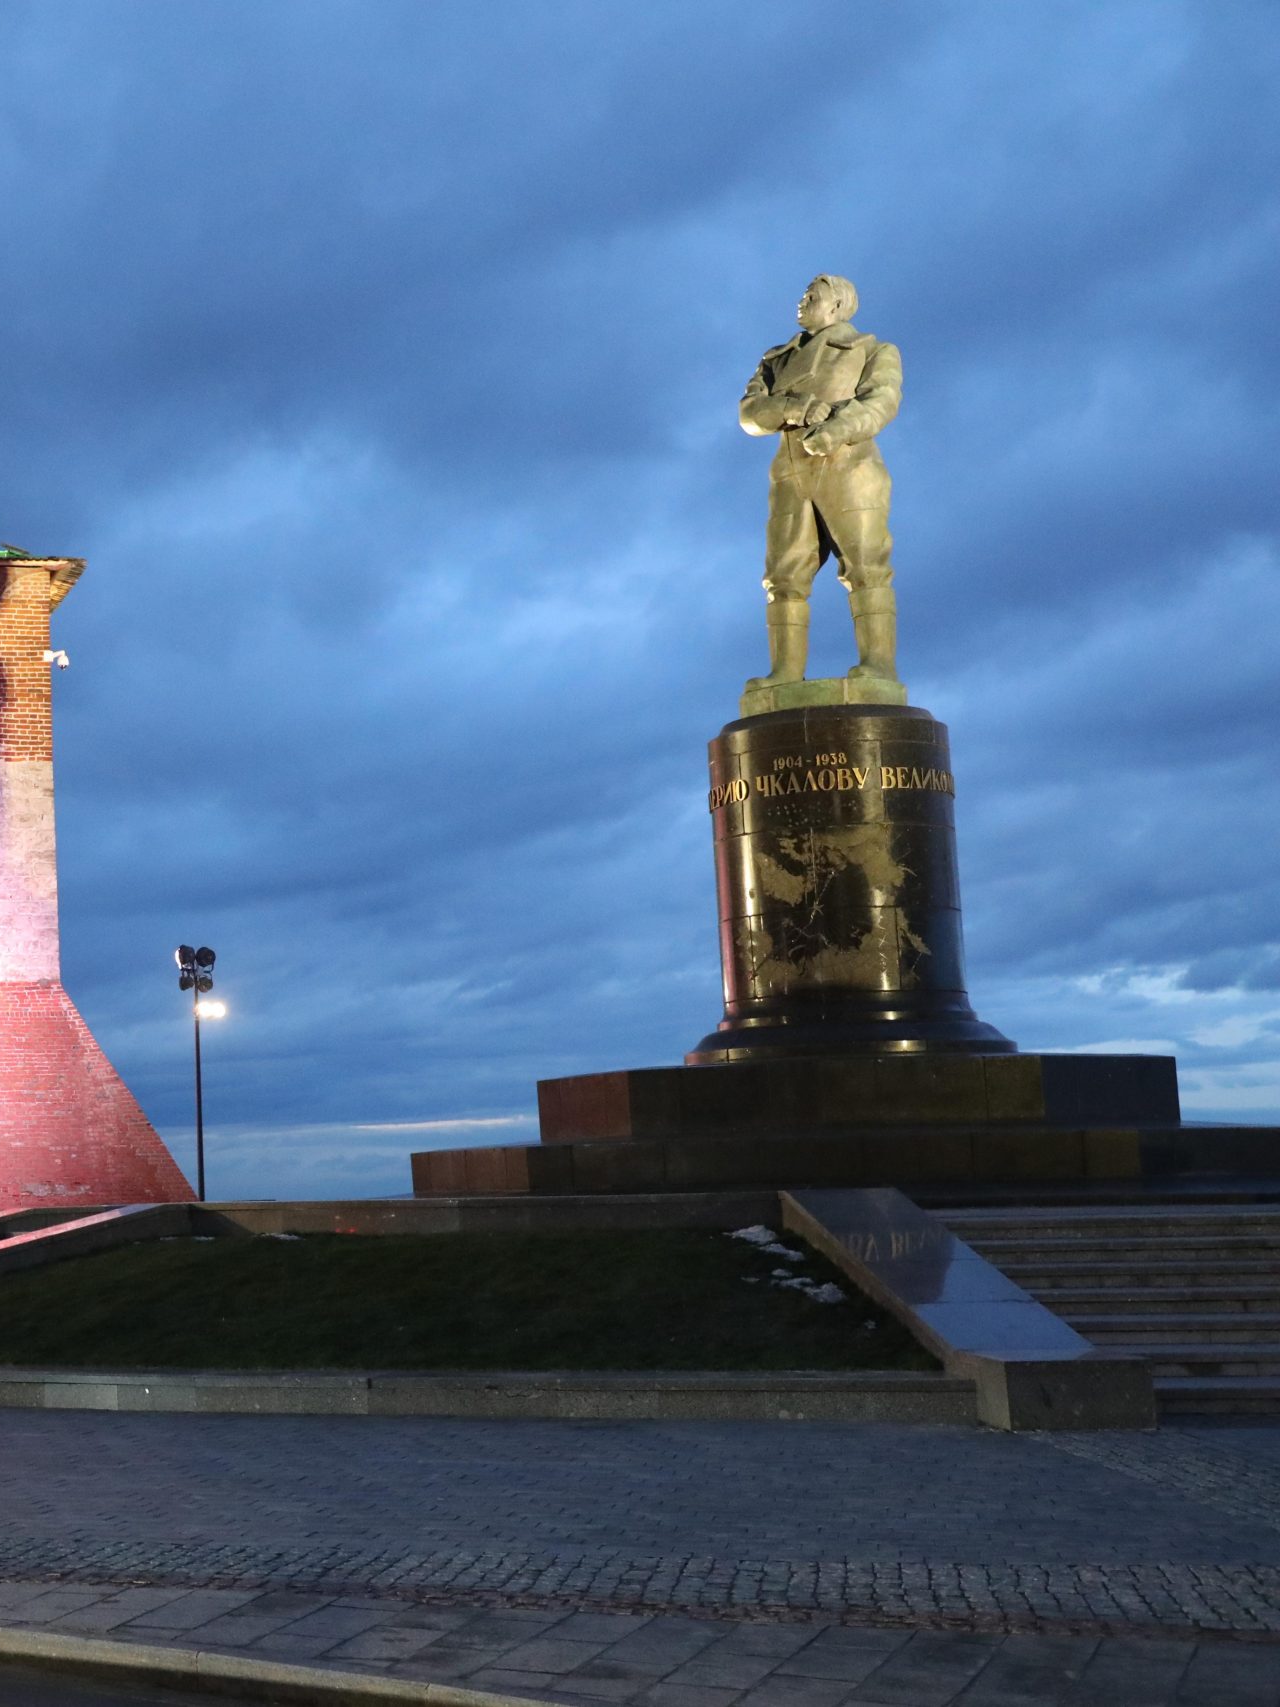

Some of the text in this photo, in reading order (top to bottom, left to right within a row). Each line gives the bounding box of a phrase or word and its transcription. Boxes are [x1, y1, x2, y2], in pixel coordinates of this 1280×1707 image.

[773, 755, 803, 771] 1904
[815, 752, 847, 767] 1938
[709, 779, 748, 810] ЕРИЮ
[755, 767, 869, 797] ЧКАЛОВУ
